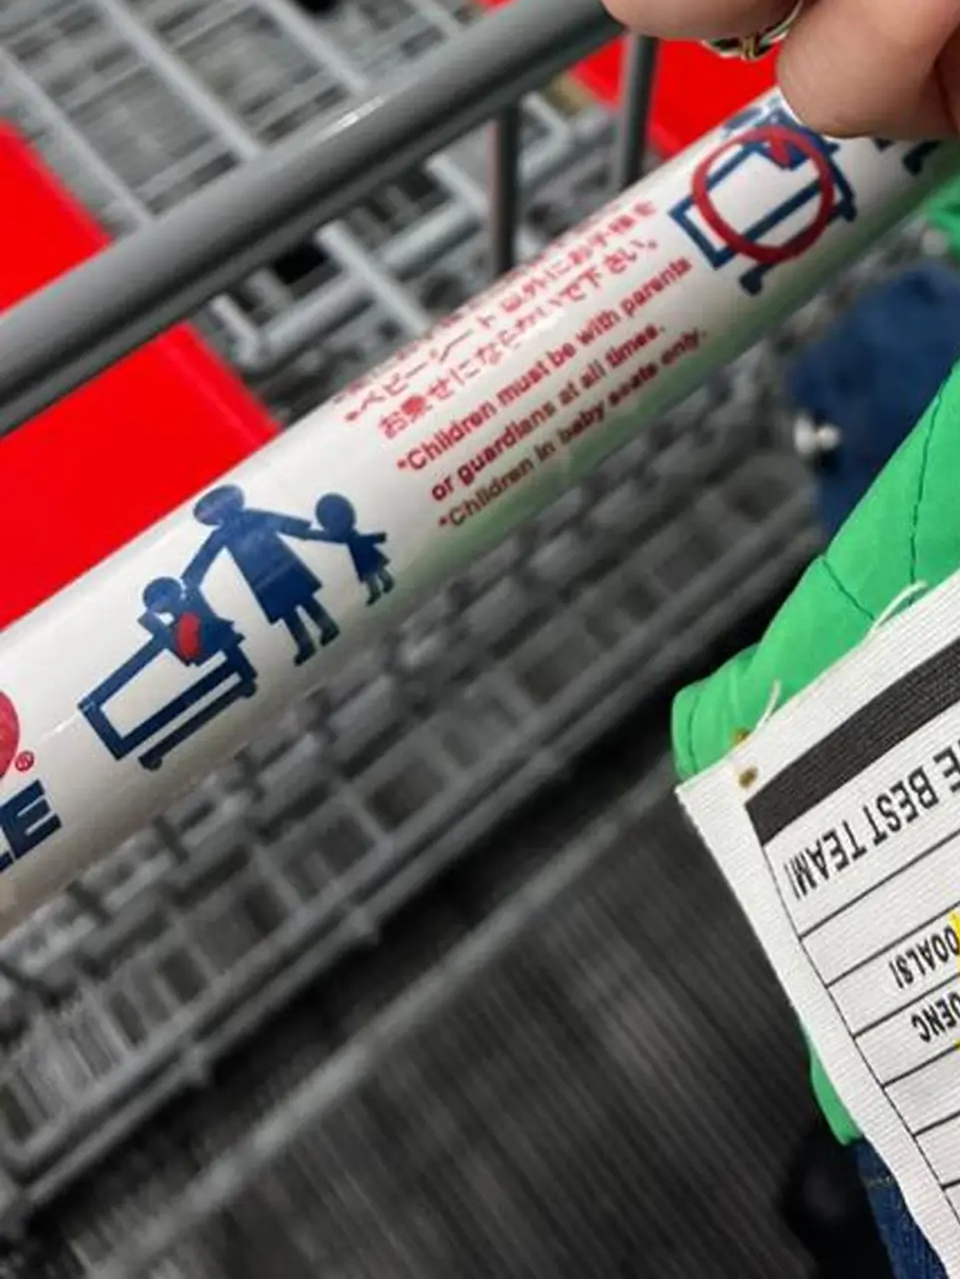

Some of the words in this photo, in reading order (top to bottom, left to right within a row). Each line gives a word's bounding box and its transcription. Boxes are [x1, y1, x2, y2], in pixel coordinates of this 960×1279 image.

[494, 357, 551, 406] must
[547, 338, 578, 368] be
[574, 305, 622, 348] with
[617, 253, 693, 318] parents
[532, 436, 558, 461] in
[554, 399, 607, 447] baby
[603, 358, 660, 407] seats
[658, 323, 708, 368] only.
[428, 475, 455, 501] or
[454, 397, 557, 487] guardians
[555, 381, 580, 405] at
[577, 359, 607, 388] all
[604, 316, 665, 368] times.
[856, 768, 941, 845] BEST
